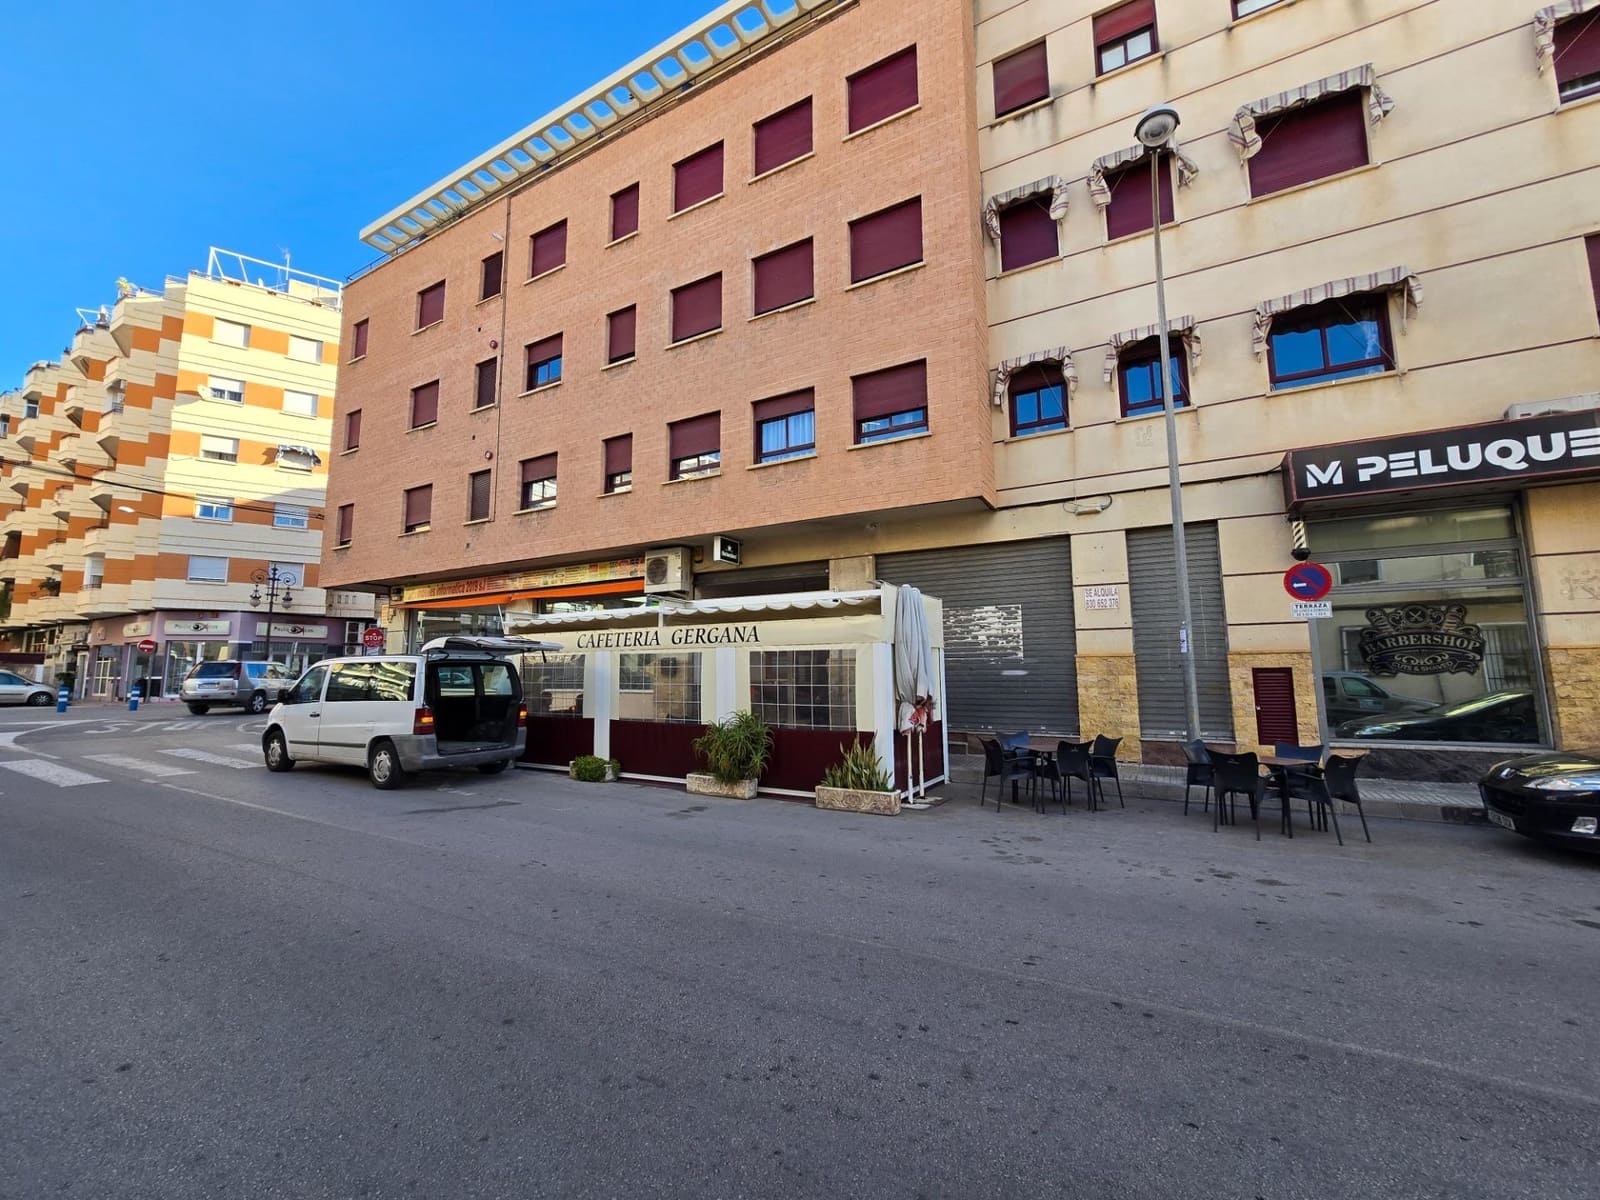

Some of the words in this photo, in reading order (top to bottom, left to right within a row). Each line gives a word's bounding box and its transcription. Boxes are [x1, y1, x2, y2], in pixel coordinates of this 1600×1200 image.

[1306, 460, 1343, 488] M
[1357, 427, 1600, 482] PELUQUE
[1085, 588, 1093, 598] SE
[1094, 587, 1118, 597] ALQUILA
[577, 630, 660, 648] CAFETERIA
[672, 625, 760, 645] GERGANA
[1365, 634, 1480, 654] BARBERSHOP
